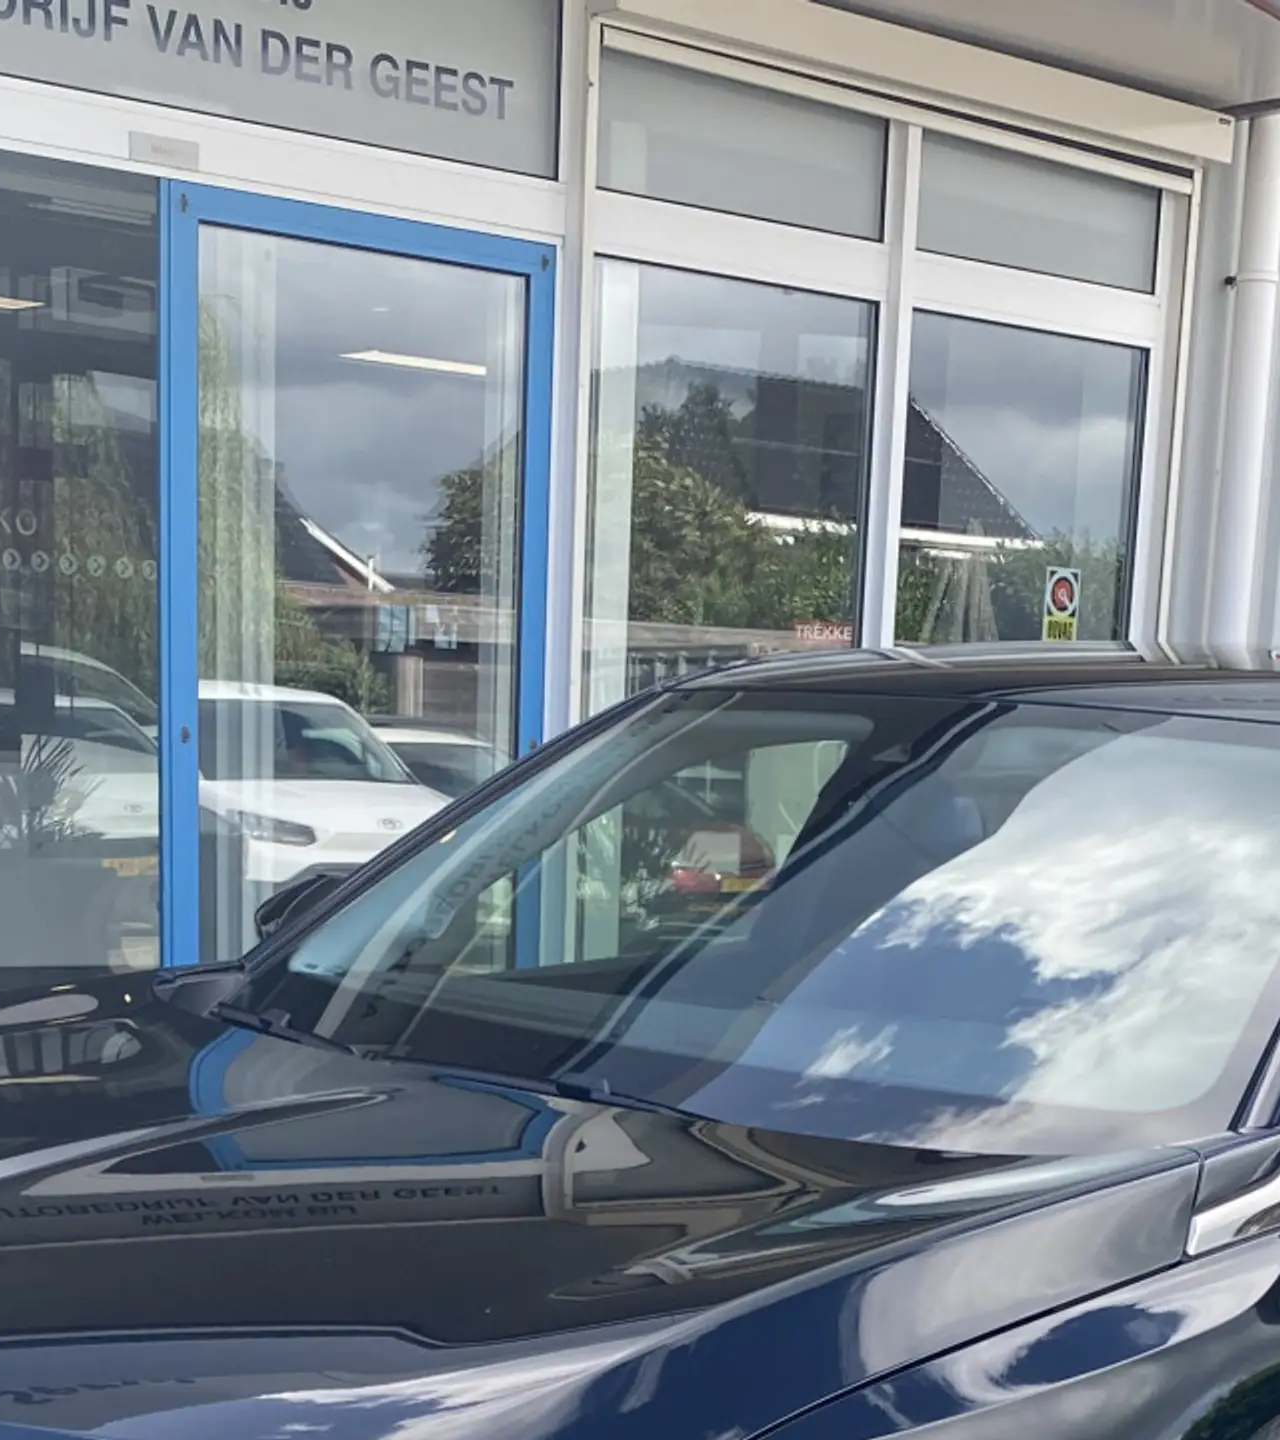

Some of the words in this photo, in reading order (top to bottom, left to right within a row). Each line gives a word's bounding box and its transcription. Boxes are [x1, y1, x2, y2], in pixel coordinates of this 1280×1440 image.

[145, 4, 243, 67] VAN
[260, 28, 354, 91] DER
[369, 52, 515, 120] GEEST
